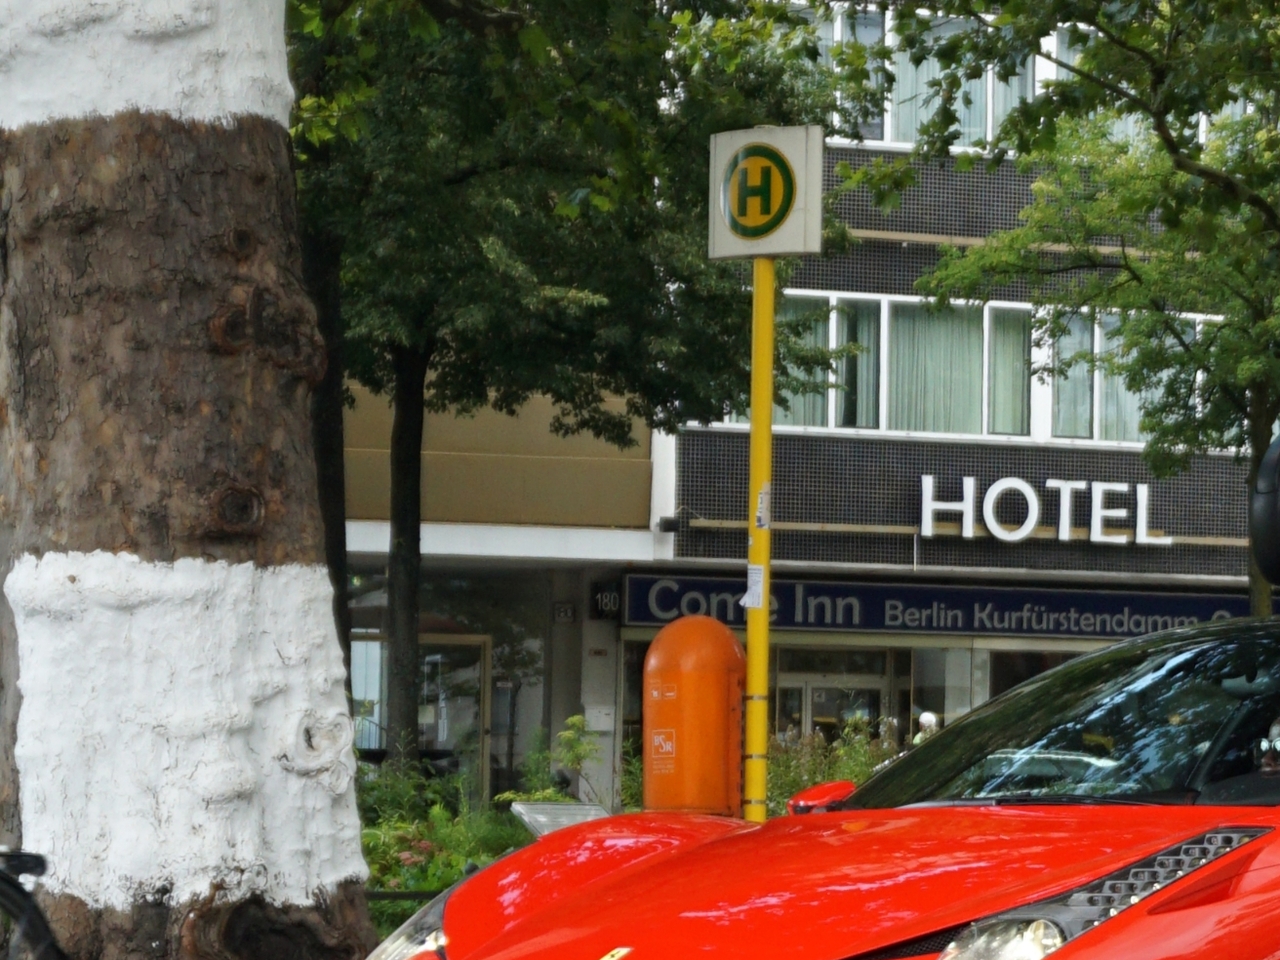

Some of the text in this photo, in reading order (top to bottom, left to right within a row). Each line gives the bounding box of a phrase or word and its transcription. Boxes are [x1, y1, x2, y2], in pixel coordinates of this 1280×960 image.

[738, 166, 771, 217] H
[921, 474, 1172, 544] HOTEL
[595, 592, 619, 611] 180
[794, 583, 860, 625] Inn
[884, 600, 963, 629] Berlin
[973, 602, 1198, 635] Kurfürstendamm
